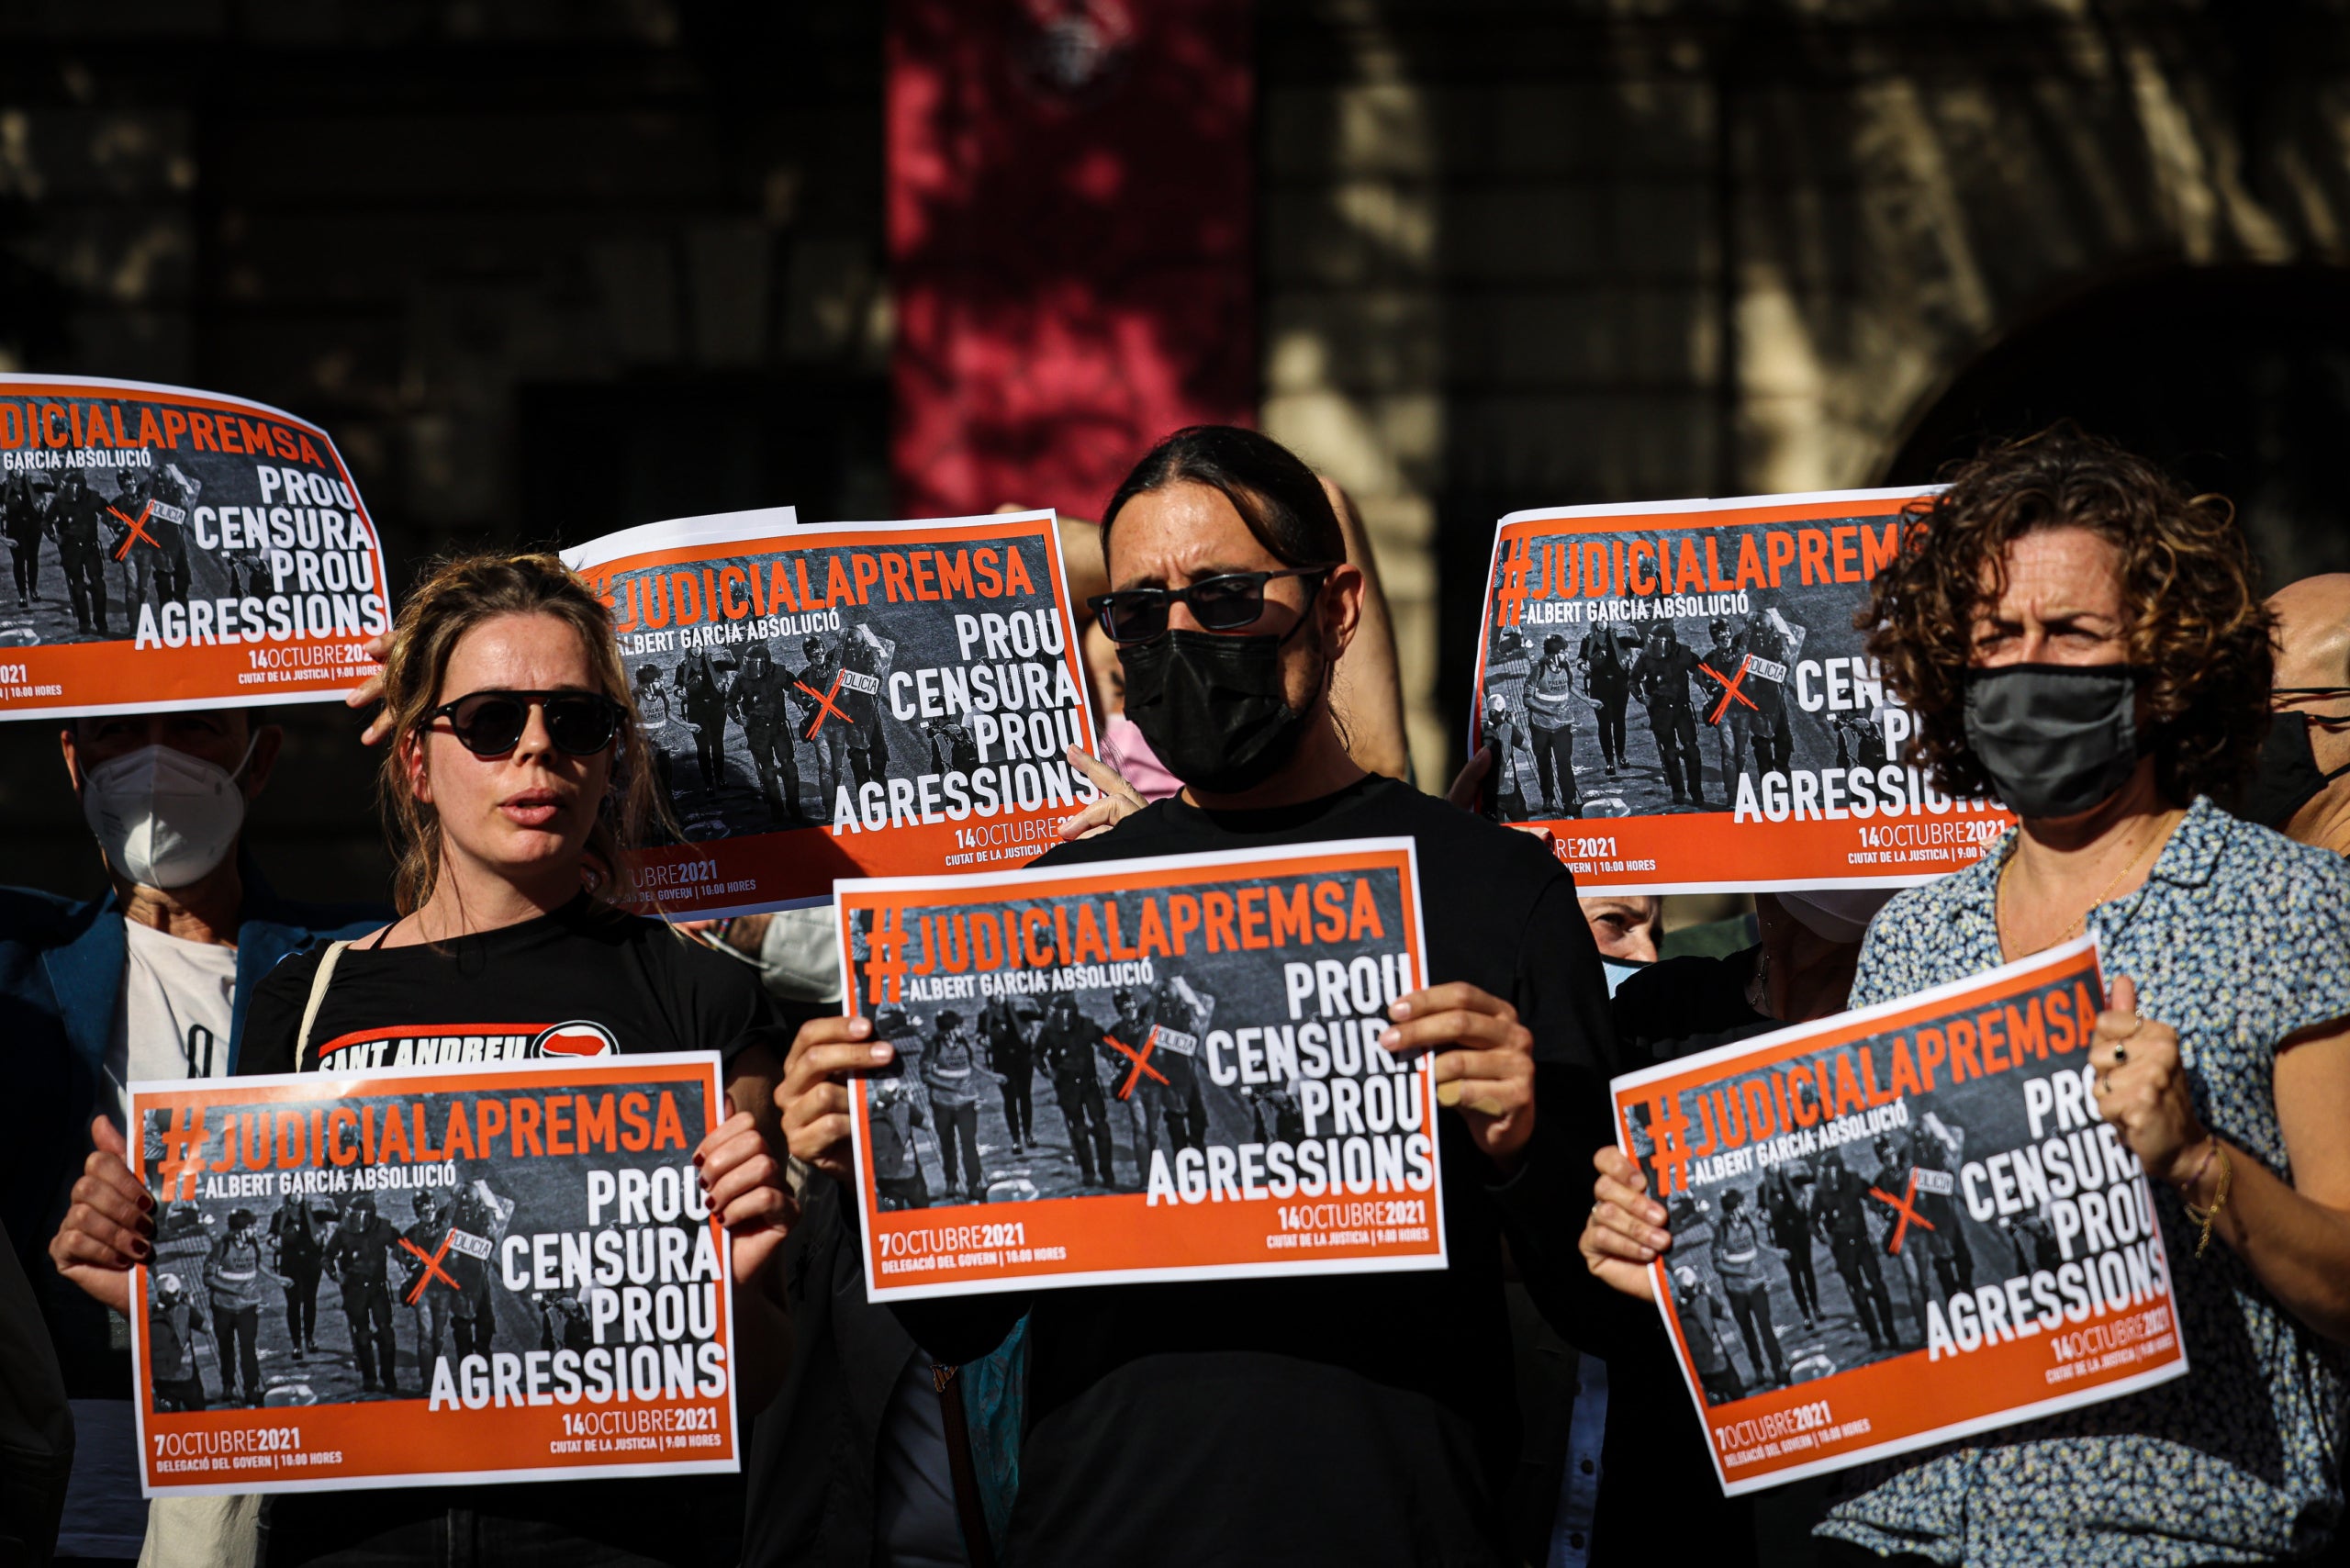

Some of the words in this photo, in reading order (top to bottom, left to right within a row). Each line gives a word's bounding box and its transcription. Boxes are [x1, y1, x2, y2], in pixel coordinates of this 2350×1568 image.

[0, 401, 326, 469] DICIALAPREMSA
[4, 451, 62, 470] GARCIA
[65, 447, 151, 469] ABSOLUCIÓ
[257, 465, 356, 510] PROU
[150, 502, 184, 524] OLICIA
[194, 506, 375, 551] CENSURA
[272, 550, 375, 593] PROU
[1497, 523, 1919, 627] #JUDICIALAPREM
[135, 594, 386, 650] AGRESSIONS
[680, 622, 742, 649] GARCIA
[747, 607, 840, 641] ABSOLUCIÓ
[1526, 602, 1582, 625] ALBERT
[1586, 599, 1649, 622] GARCIA
[1652, 588, 1749, 619] ABSOLUCIÓ
[249, 644, 373, 669] 14OCTUBRE202
[955, 608, 1065, 661] PROU
[35, 684, 62, 696] HORES
[239, 673, 265, 685] CIUTAT
[267, 671, 279, 682] DE
[280, 670, 292, 681] LA
[293, 667, 330, 681] JUSTICIA
[888, 660, 1082, 721] CENSURA
[973, 708, 1084, 763] PROU
[832, 761, 1101, 835] AGRESSIONS
[955, 816, 1074, 849] 14OCTUBRE
[1555, 837, 1617, 858] RE2021
[1859, 819, 2006, 848] 14OCTUBRE2021
[630, 858, 718, 889] UBRE2021
[945, 853, 973, 867] CIUTAT
[977, 850, 988, 863] DE
[990, 848, 1002, 860] LA
[1003, 844, 1043, 859] JUSTICIA
[1600, 860, 1624, 872] 10:00
[1627, 859, 1656, 871] HORES
[1848, 851, 1877, 865] CIUTAT
[1879, 849, 1892, 862] DE
[1894, 848, 1907, 862] LA
[1908, 846, 1949, 862] JUSTICIA
[1957, 846, 1977, 858] 9:00
[658, 887, 692, 902] GOVERN
[701, 882, 725, 897] 10:00
[727, 879, 756, 893] HORES
[864, 877, 1384, 1004] #JUDICIALAPREMSA
[910, 974, 975, 1002] ALBERT
[979, 969, 1047, 997] GARCIA
[1051, 957, 1154, 992] ABSOLUCIÓ
[1284, 952, 1414, 1020] PROU
[1205, 1017, 1427, 1087] CENSUR
[1300, 1071, 1423, 1137] PROU
[1645, 980, 2097, 1197] #JUDICIALAPREMSA
[159, 1091, 687, 1201] #JUDICIALAPREMSA
[1694, 1148, 1754, 1186] ALBERT
[1756, 1128, 1817, 1166] GARCIA
[1818, 1098, 1908, 1151] ABSOLUCIÓ
[205, 1170, 273, 1199] ALBERT
[279, 1167, 346, 1195] GARCIA
[352, 1160, 456, 1191] ABSOLUCIÓ
[1146, 1133, 1434, 1206] AGRESSIONS
[588, 1166, 711, 1226] PROU
[1278, 1199, 1426, 1230] 14OCTUBRE2021
[878, 1221, 1025, 1257] 7OCTUBRE2021
[1314, 1232, 1327, 1247] LA
[2050, 1182, 2154, 1260] PROU
[501, 1226, 722, 1291] CENSURA
[937, 1255, 957, 1270] DEL
[592, 1284, 716, 1345] PROU
[1927, 1236, 2168, 1362] AGRESSIONS
[429, 1341, 727, 1412] AGRESSIONS
[154, 1427, 300, 1456] 7OCTUBRE2021
[550, 1439, 582, 1453] CIUTAT
[584, 1439, 597, 1452] DE
[599, 1438, 612, 1450] LA
[614, 1436, 657, 1450] JUSTICIA
[688, 1433, 721, 1448] HORES
[562, 1406, 717, 1436] 14OCTUBRE2021
[1715, 1399, 1832, 1451] 7OCTUBRE2021
[157, 1455, 209, 1473] DELEGACIÓ
[212, 1457, 230, 1470] DEL
[233, 1454, 272, 1469] GOVERN
[309, 1450, 342, 1465] HORES
